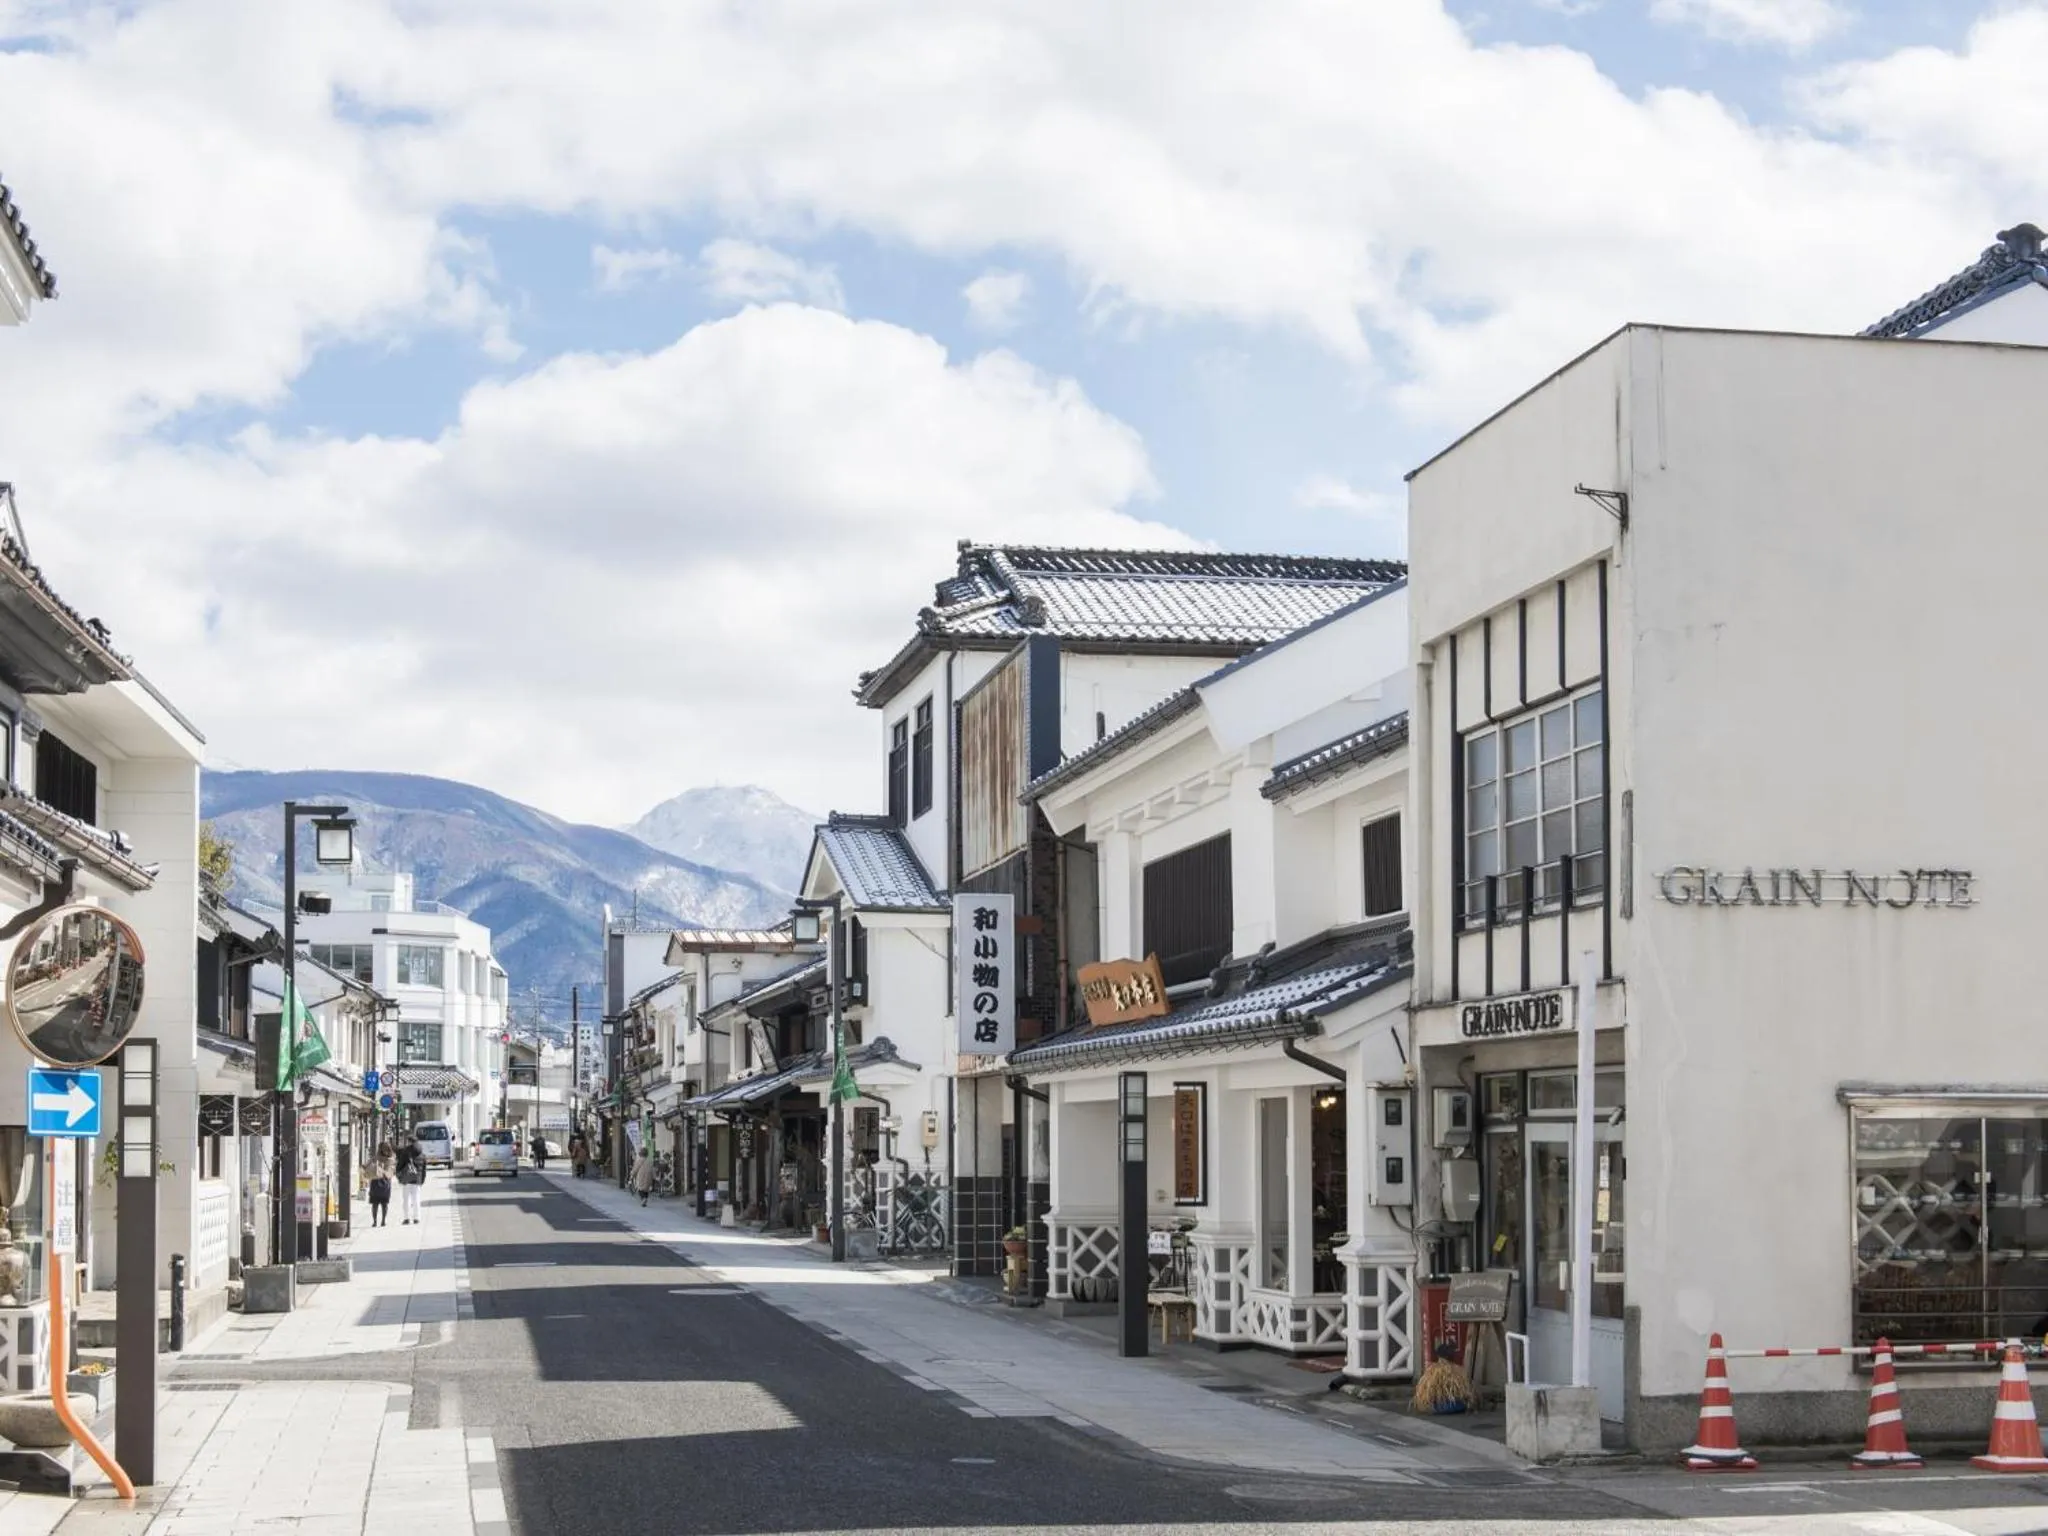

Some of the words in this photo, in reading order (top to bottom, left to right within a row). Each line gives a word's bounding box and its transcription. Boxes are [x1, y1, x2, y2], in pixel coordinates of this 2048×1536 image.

[973, 906, 1000, 1044] 和小物の店
